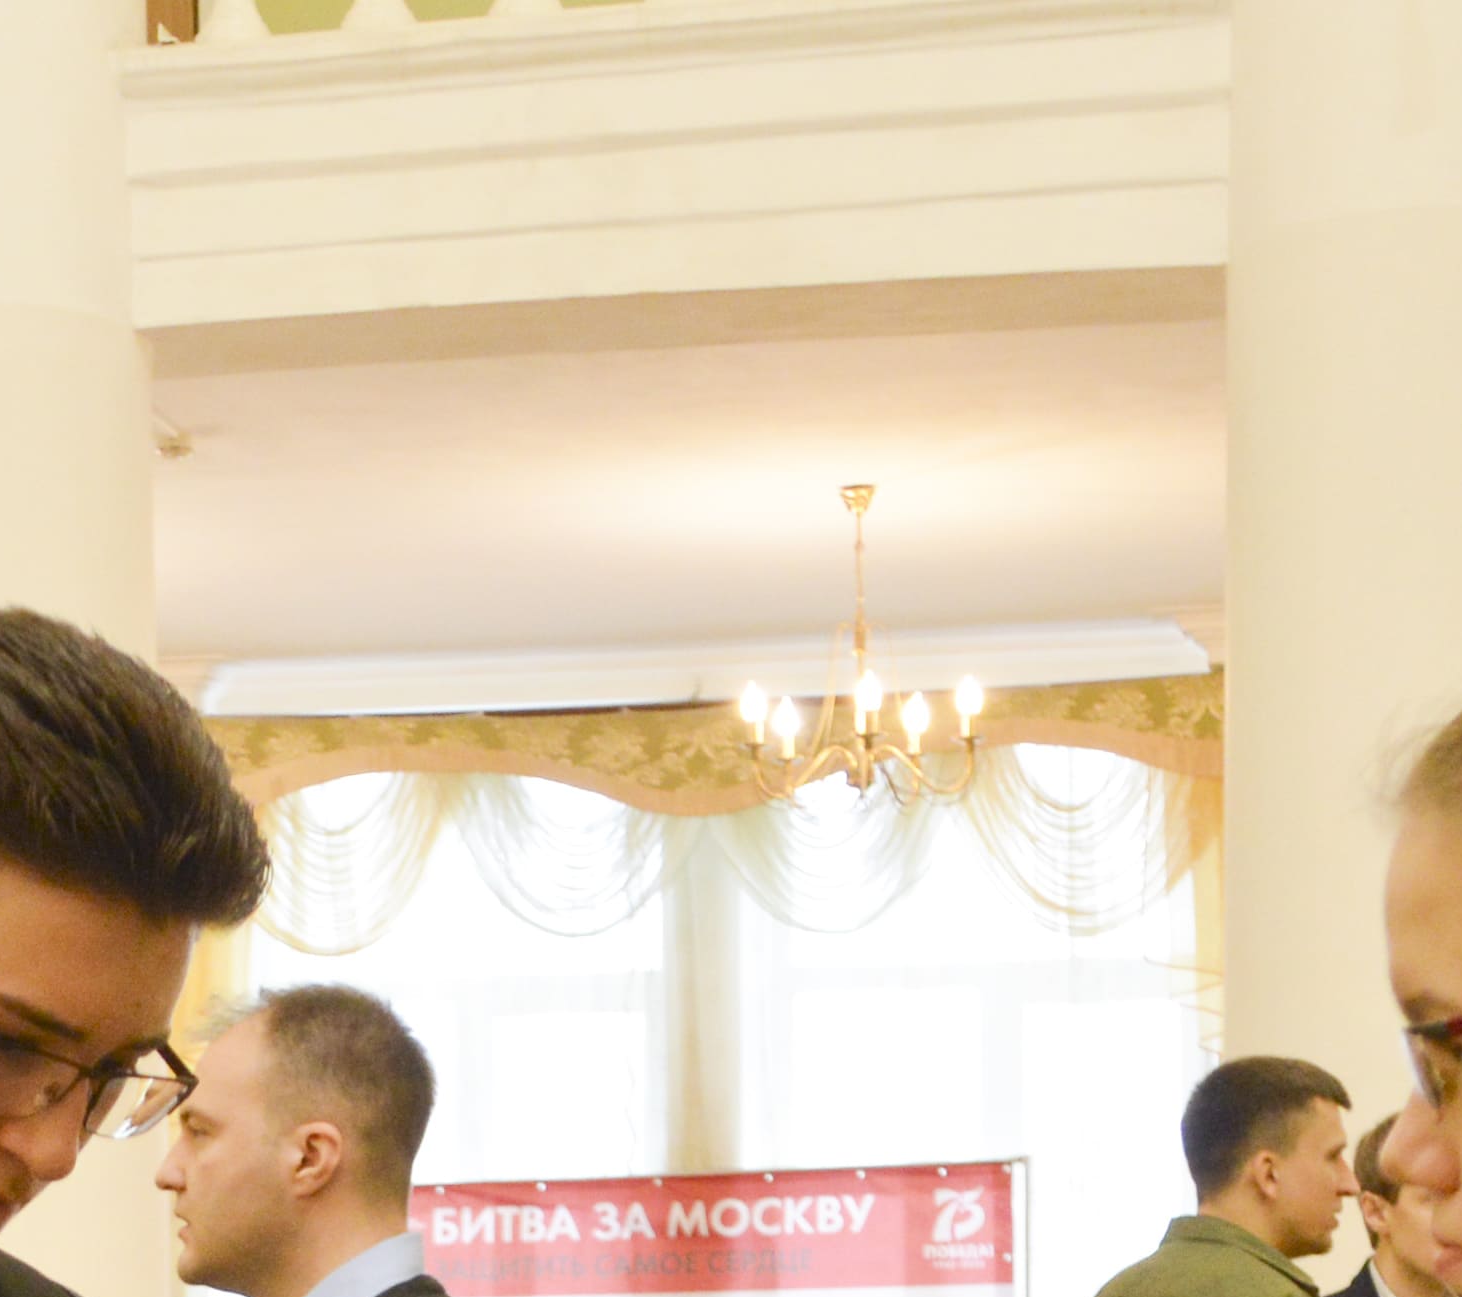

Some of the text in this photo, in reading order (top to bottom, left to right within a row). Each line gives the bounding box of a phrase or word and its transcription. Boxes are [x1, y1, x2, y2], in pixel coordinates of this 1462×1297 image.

[433, 1194, 875, 1244] БИТВА ЗА МОСКВУ
[594, 1252, 698, 1276] САМОЕ
[708, 1248, 811, 1276] СЕРДЦЕ
